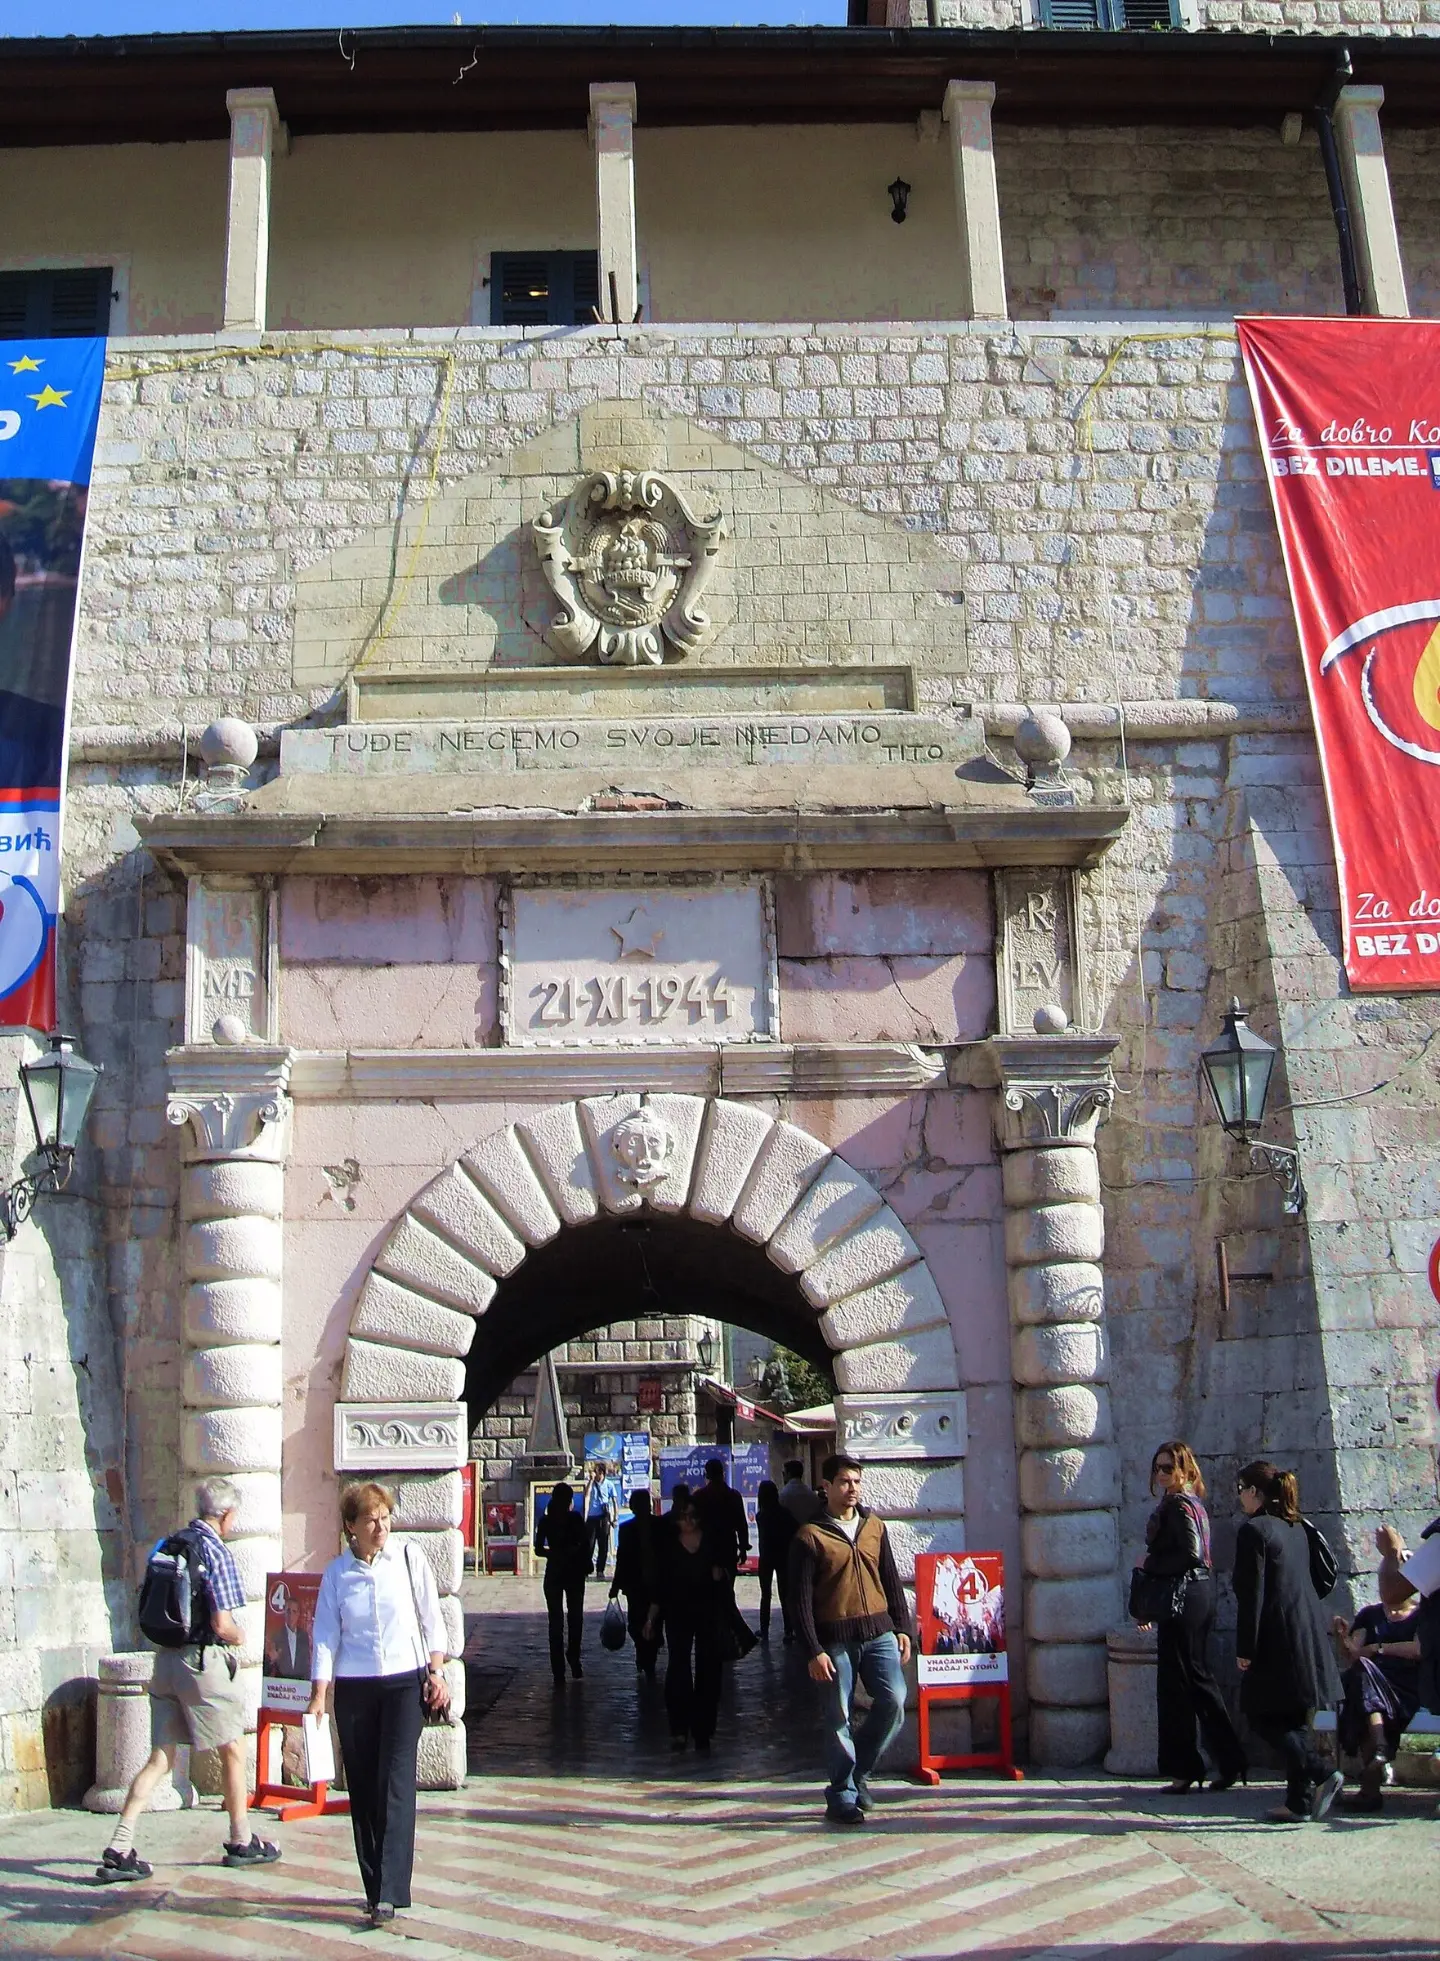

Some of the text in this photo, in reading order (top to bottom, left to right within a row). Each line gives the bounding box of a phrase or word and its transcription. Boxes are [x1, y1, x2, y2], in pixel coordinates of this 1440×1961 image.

[1320, 418, 1392, 443] dobro
[1271, 456, 1320, 476] BEZ
[1326, 457, 1428, 476] DILEME.
[606, 727, 721, 748] SVOJE
[881, 744, 944, 762] TITO
[1354, 892, 1393, 919] Za
[1355, 934, 1411, 957] BEZ
[535, 974, 736, 1023] 21-XI-1944
[272, 1584, 285, 1610] 4
[957, 1572, 979, 1600] 4
